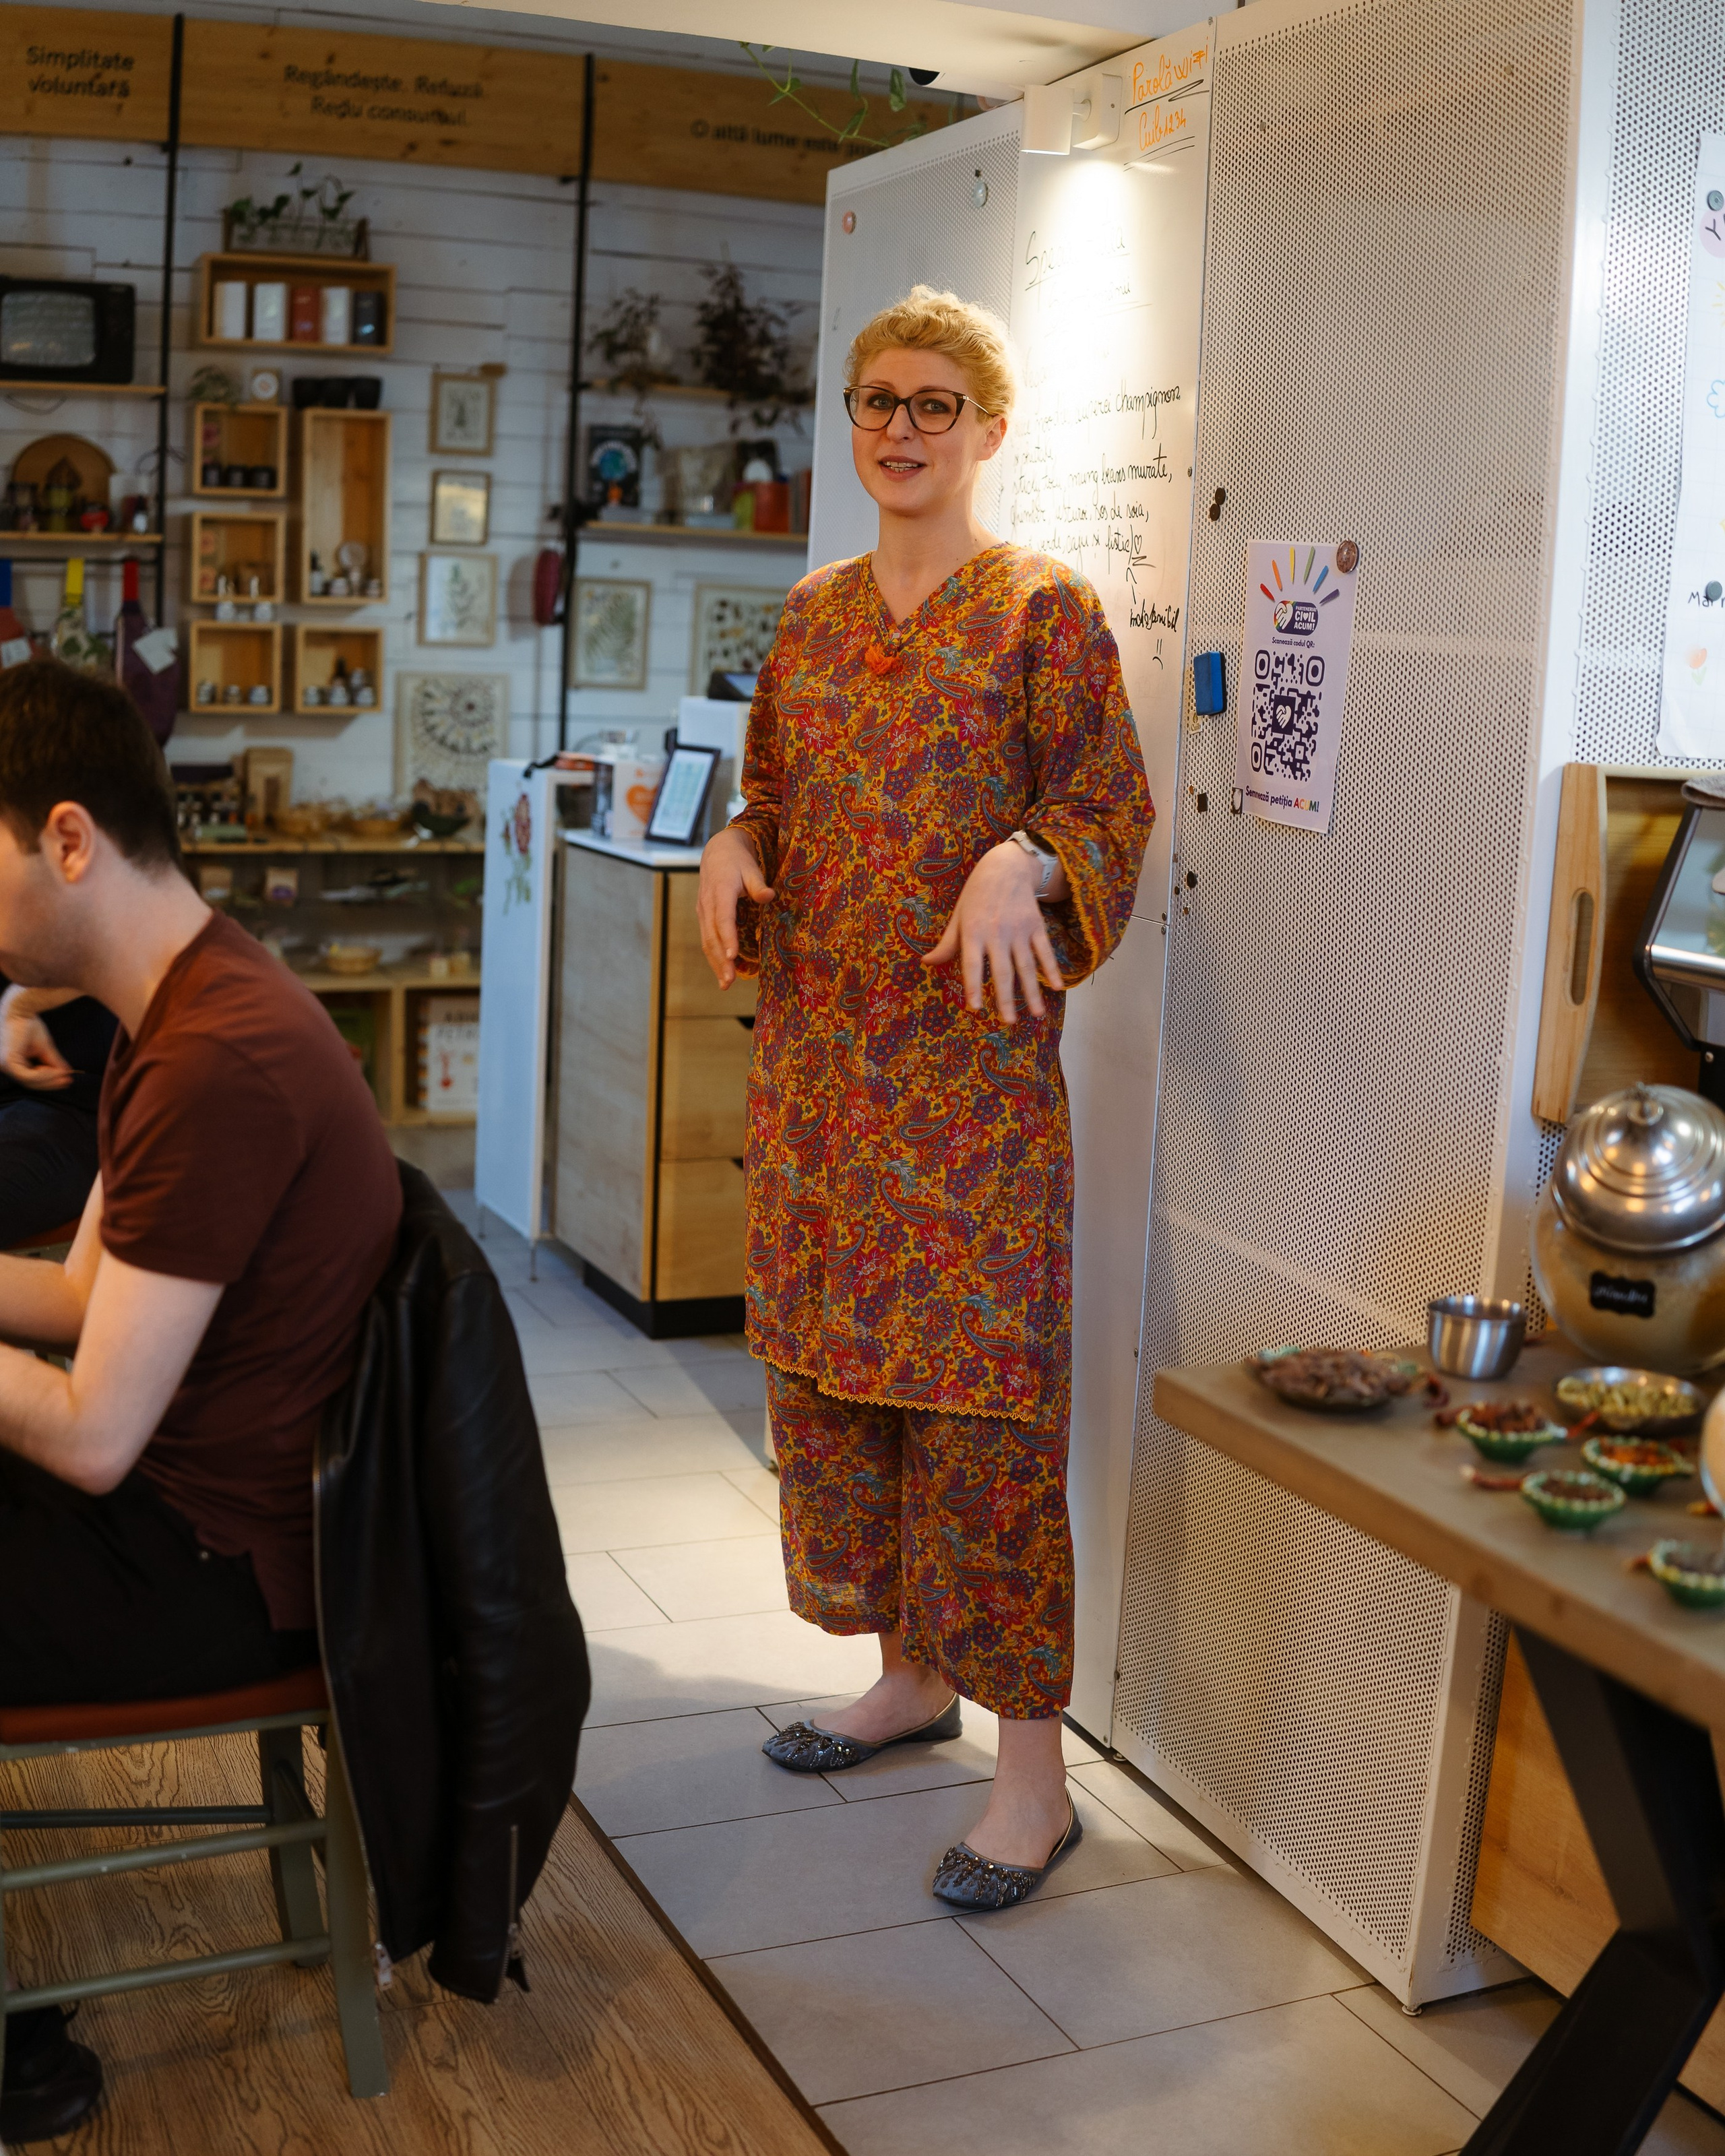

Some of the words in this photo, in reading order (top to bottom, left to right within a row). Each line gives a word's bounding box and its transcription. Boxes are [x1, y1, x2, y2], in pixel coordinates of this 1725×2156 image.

[26, 45, 134, 71] Simplitate
[28, 75, 129, 98] voluntară
[1294, 622, 1315, 631] ACUM!
[1272, 637, 1293, 645] Scanează
[1245, 785, 1269, 802] Semnează
[1293, 798, 1319, 813] ACUM!
